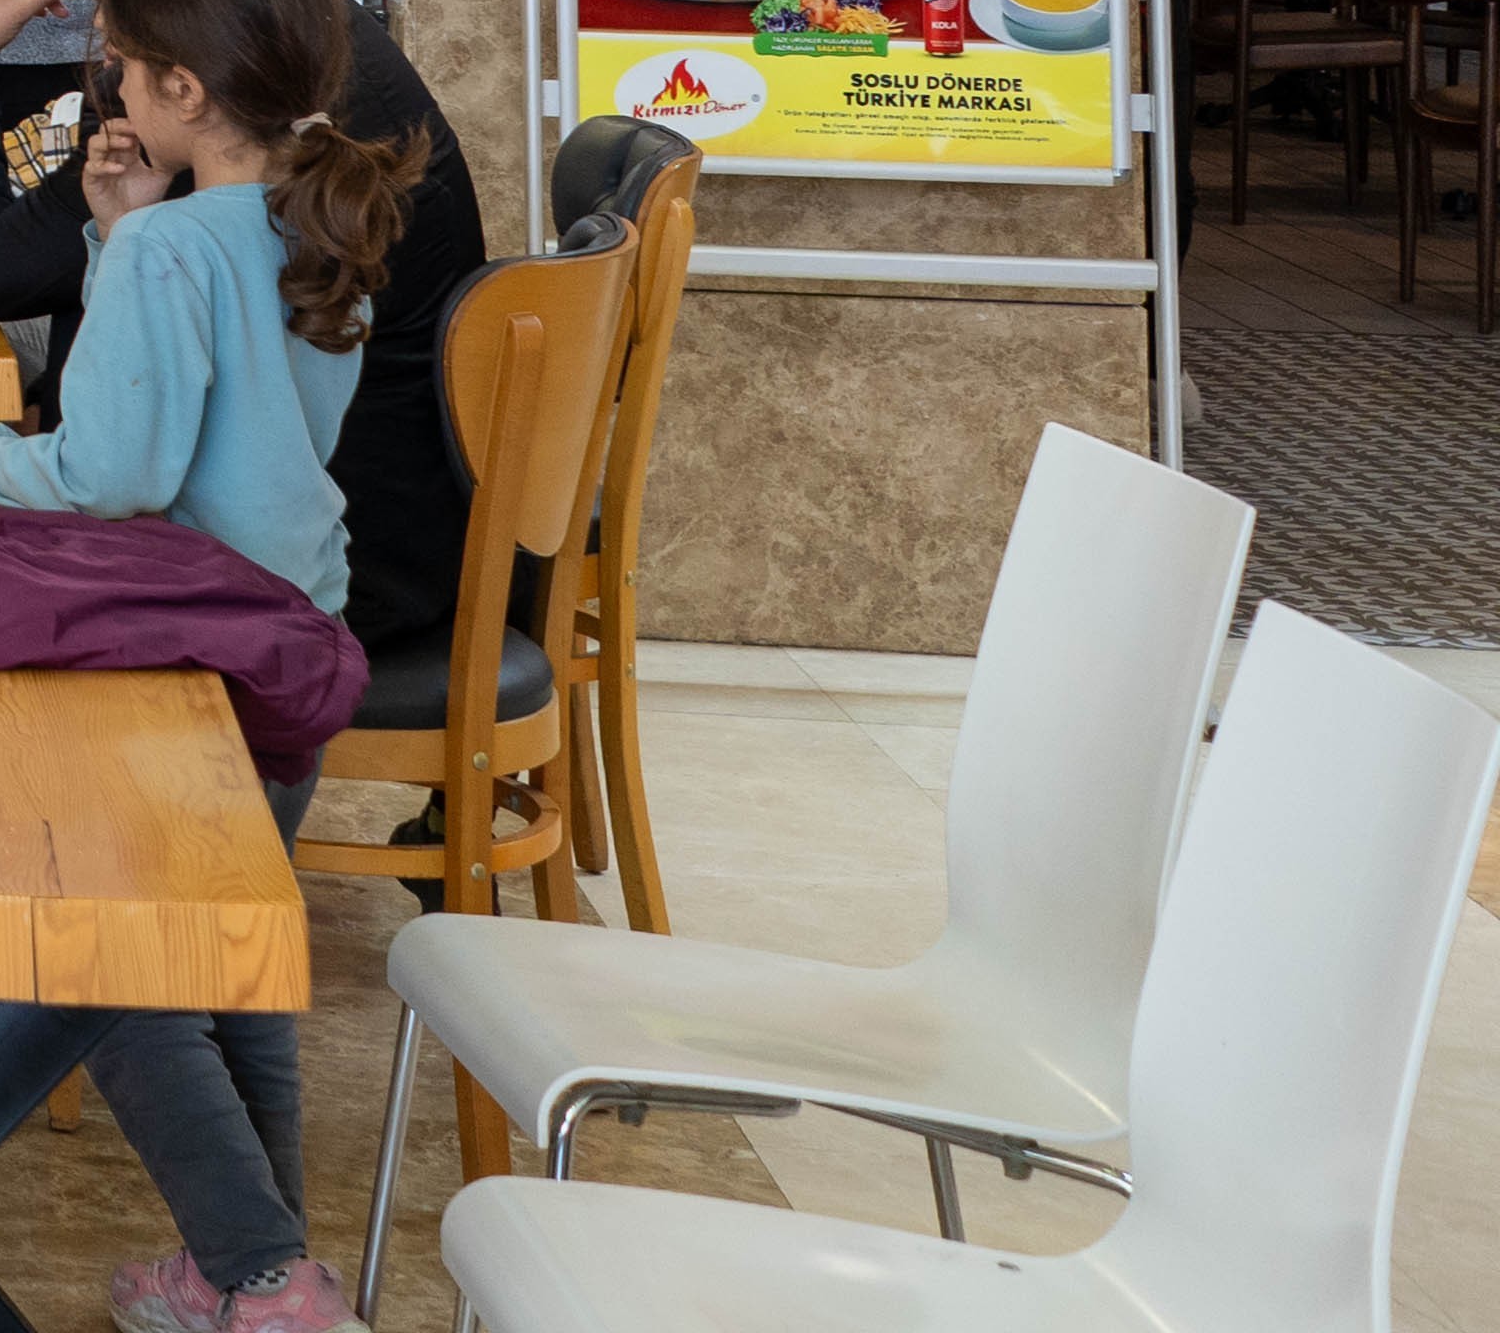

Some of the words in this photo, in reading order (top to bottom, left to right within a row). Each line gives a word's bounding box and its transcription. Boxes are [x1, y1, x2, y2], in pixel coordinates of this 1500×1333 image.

[931, 21, 958, 30] KOLA
[851, 74, 919, 91] SOSLU
[926, 71, 1022, 93] DÖNERDE
[843, 86, 933, 109] TÜRKİYE
[937, 94, 1032, 113] MARKASI
